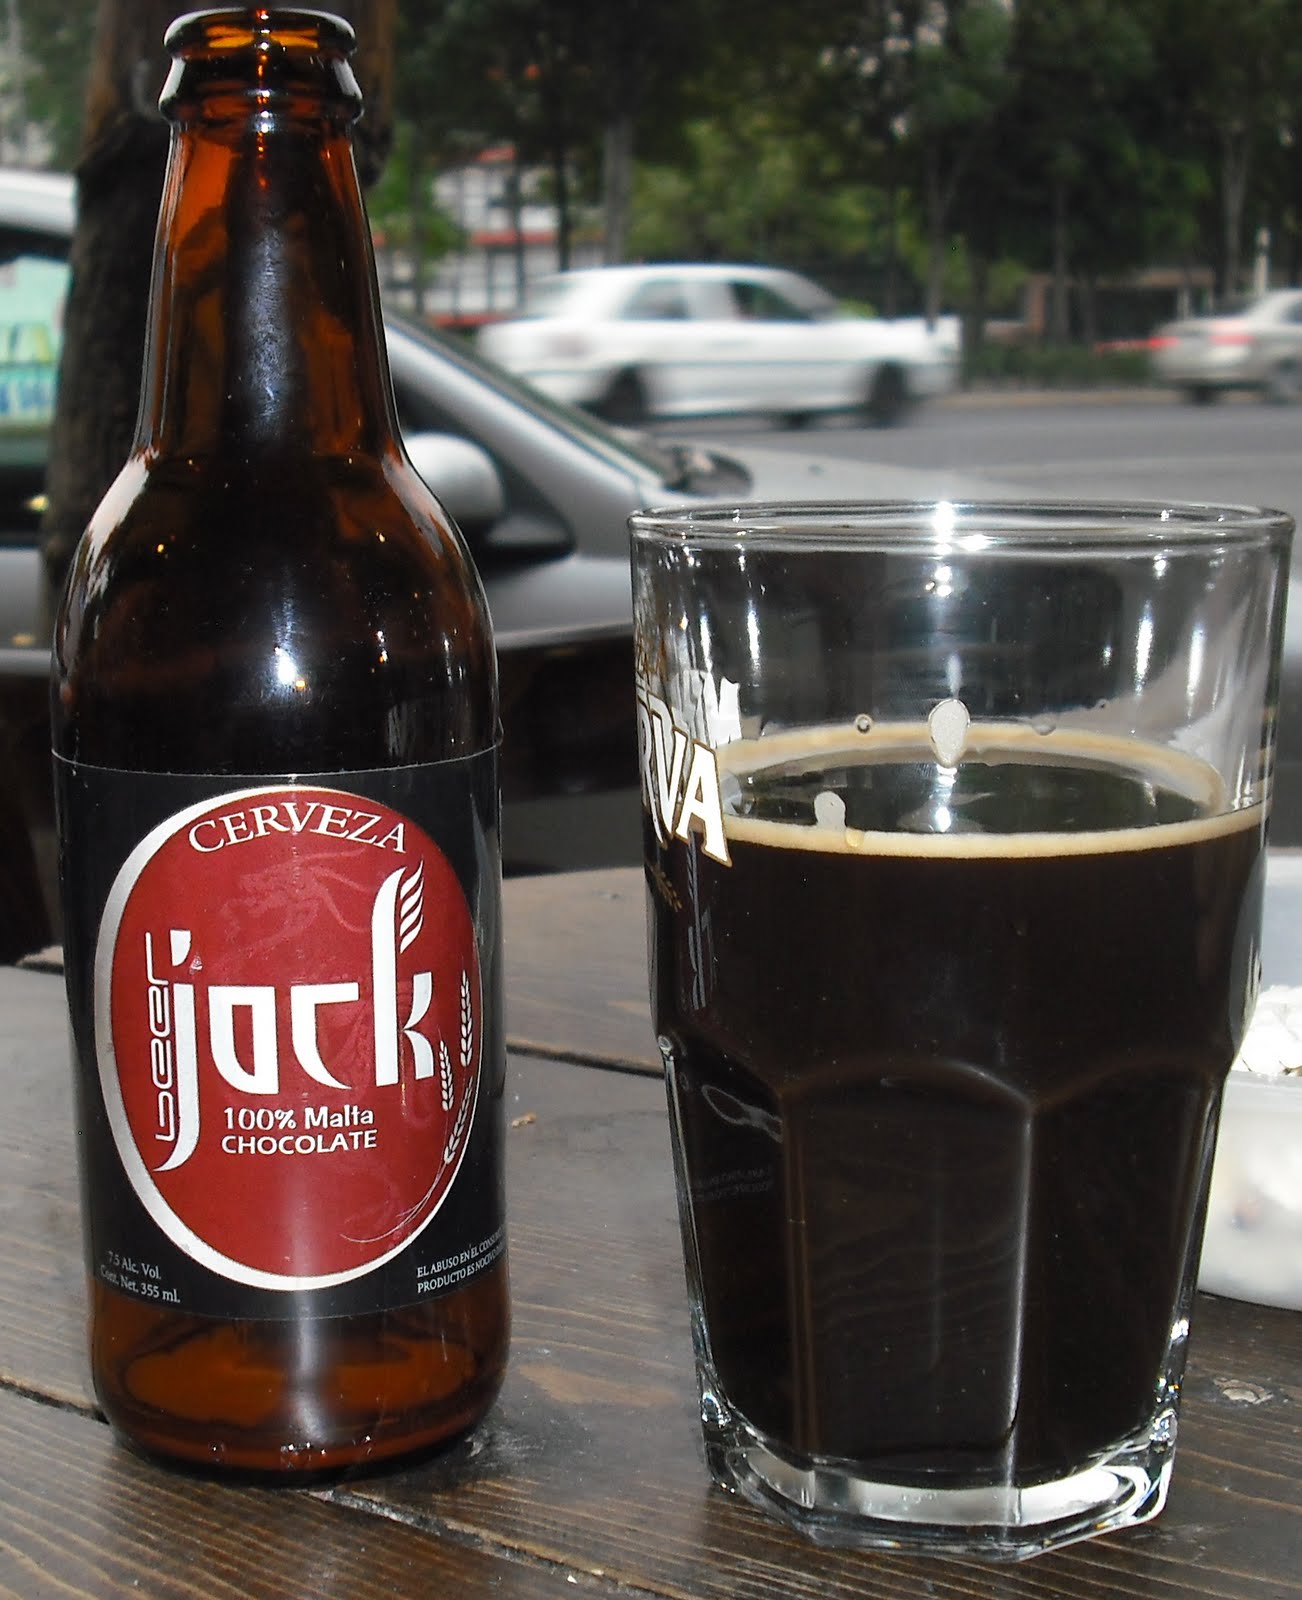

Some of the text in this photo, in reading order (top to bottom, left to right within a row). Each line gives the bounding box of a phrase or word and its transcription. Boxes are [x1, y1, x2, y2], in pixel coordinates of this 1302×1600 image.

[189, 802, 406, 853] CERVEZA
[145, 931, 176, 1142] beer
[223, 1104, 374, 1131] 100% Malta
[221, 1129, 378, 1155] CHOCOLATE
[122, 1257, 139, 1275] Alc.
[141, 1263, 162, 1280] Vol.
[417, 1266, 429, 1278] EL
[430, 1255, 459, 1274] ABUSO
[460, 1250, 470, 1264] EN
[470, 1246, 480, 1259] EL
[120, 1274, 139, 1293] Net.
[141, 1282, 160, 1298] 355
[162, 1288, 181, 1303] ml.
[417, 1267, 466, 1294] PRODUCTO
[466, 1263, 475, 1276] ES
